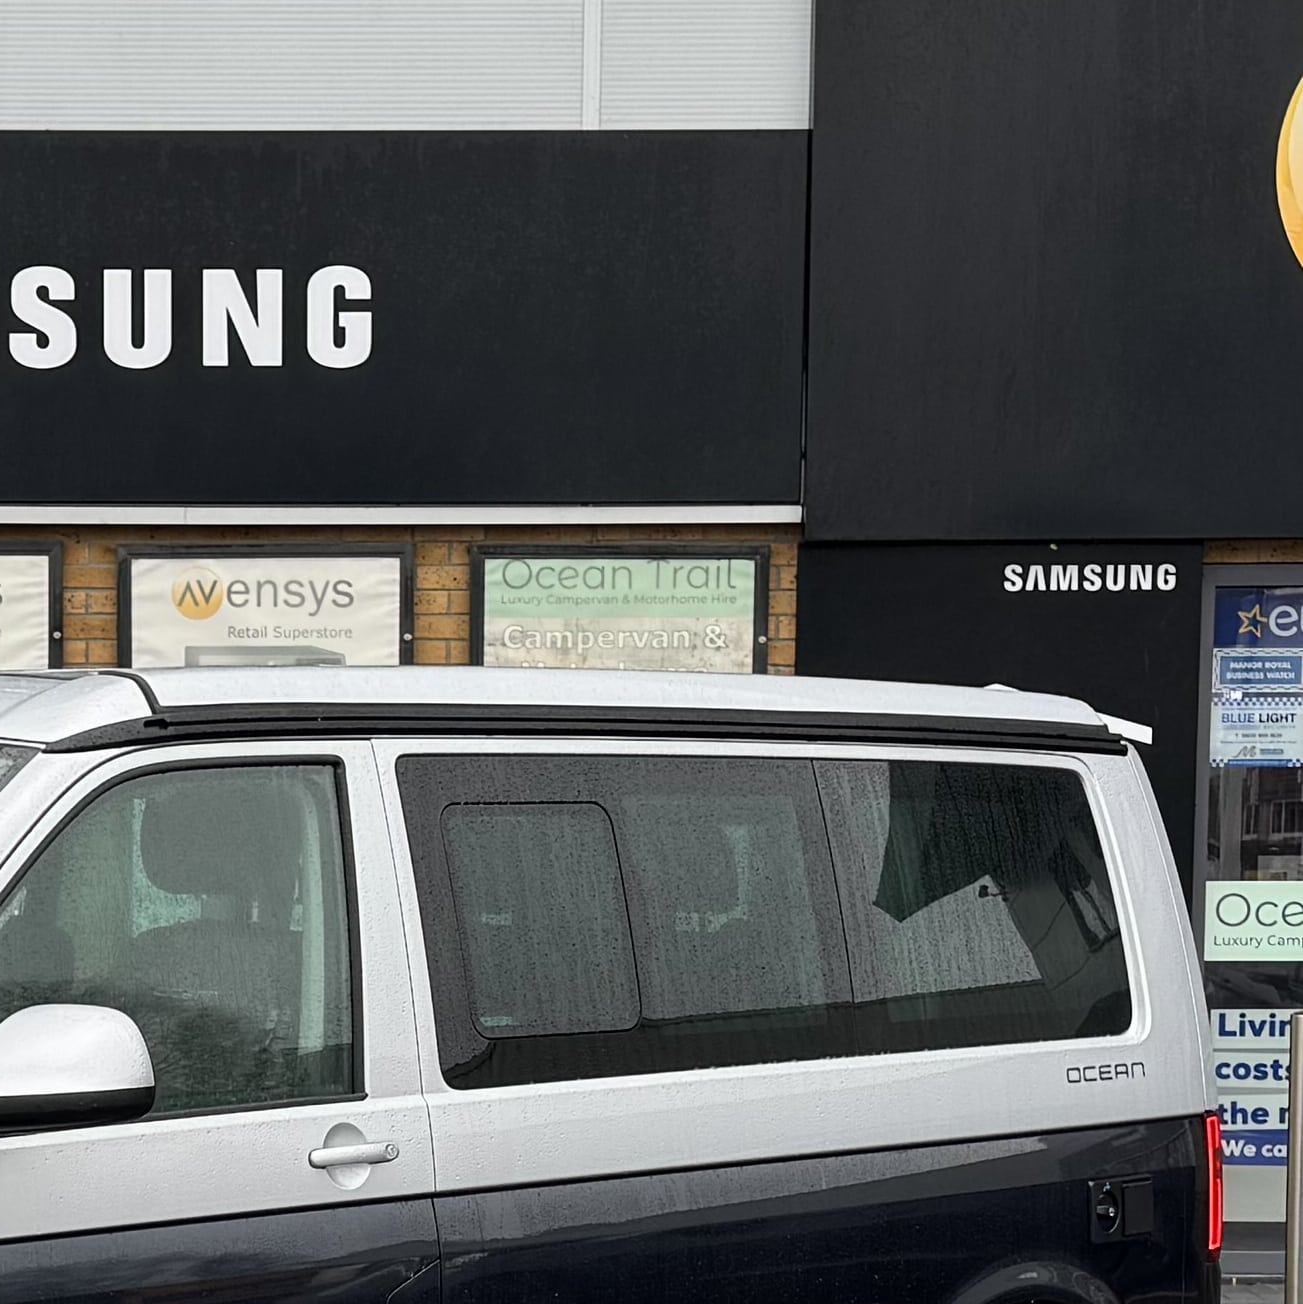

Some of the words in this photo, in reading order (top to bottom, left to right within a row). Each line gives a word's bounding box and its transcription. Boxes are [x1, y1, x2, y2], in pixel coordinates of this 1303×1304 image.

[502, 558, 633, 590] Ocean
[647, 558, 737, 590] Trail
[1003, 563, 1177, 592] SAMSUNG
[501, 593, 542, 606] Luxury
[546, 593, 618, 607] Campervan
[622, 594, 631, 605] &
[634, 594, 707, 605] Motorhome
[711, 593, 737, 605] Hire
[227, 626, 267, 639] Retail
[273, 626, 353, 641] Superstore
[503, 625, 691, 654] Campervan
[703, 624, 729, 649] &
[1226, 671, 1264, 680] BUSINESS
[1222, 712, 1255, 724] BLUE
[1259, 712, 1296, 724] LIGHT
[1213, 935, 1263, 949] Luxury
[1066, 1062, 1146, 1084] OCEAN
[1217, 1101, 1270, 1125] the
[1220, 1139, 1257, 1157] We
